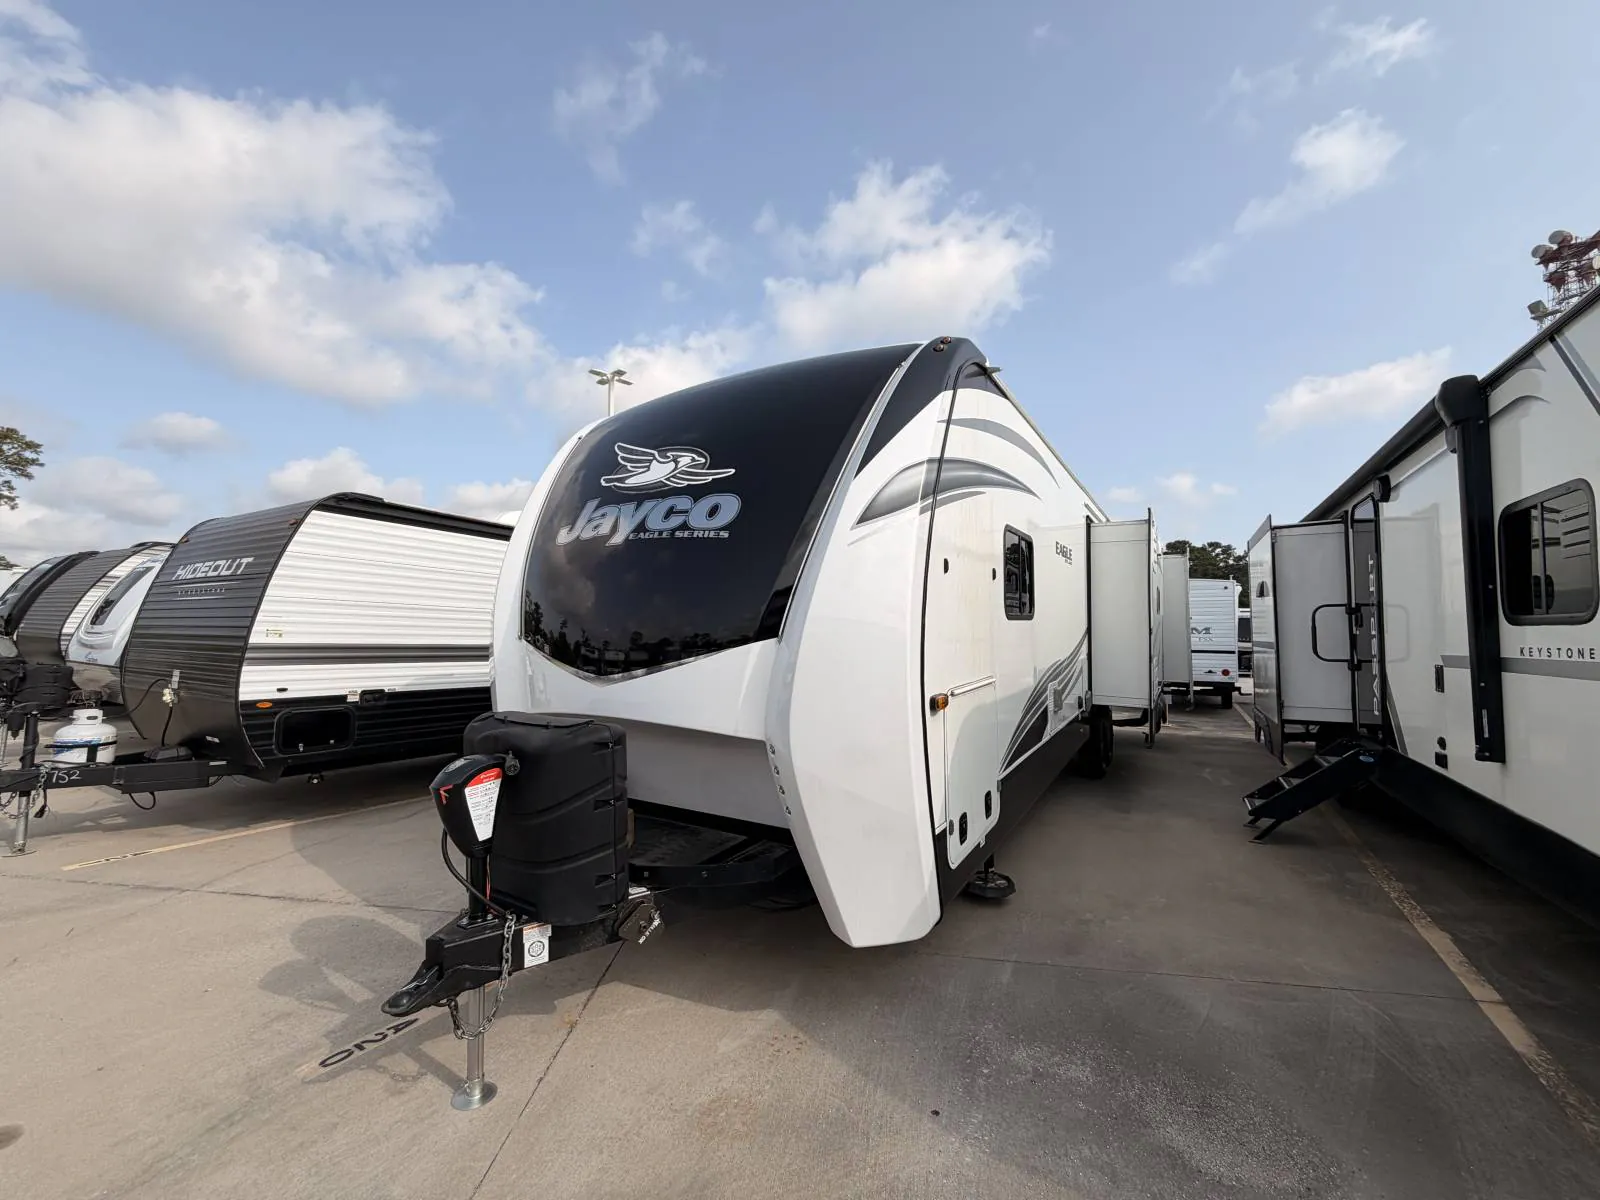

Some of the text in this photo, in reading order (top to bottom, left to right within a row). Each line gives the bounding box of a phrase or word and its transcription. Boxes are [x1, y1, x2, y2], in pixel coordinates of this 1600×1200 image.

[556, 493, 742, 547] Jayco
[628, 530, 729, 540] EAGLE SERIES
[1055, 540, 1073, 561] EAGLE
[171, 556, 256, 580] HIDEOUT
[1519, 646, 1596, 660] KEYSTONE
[51, 769, 82, 784] 752
